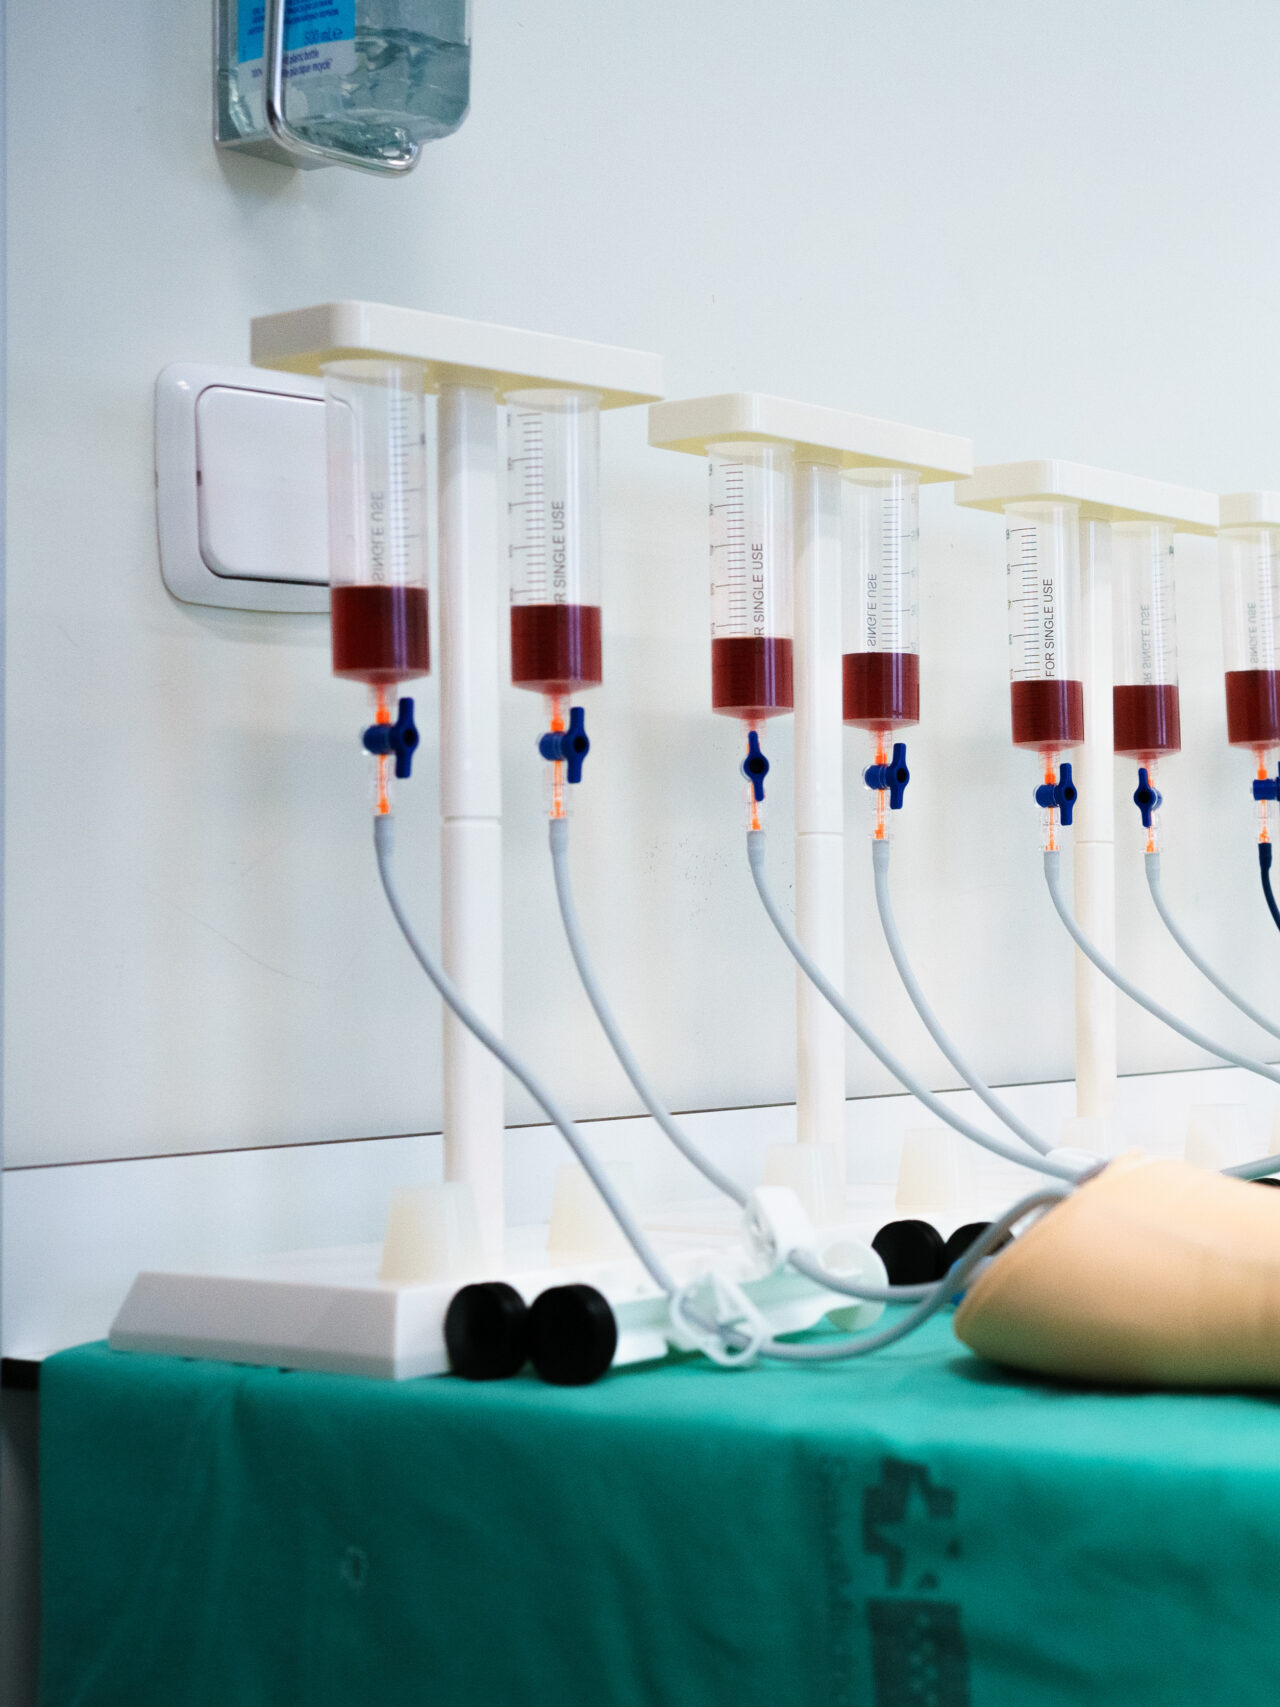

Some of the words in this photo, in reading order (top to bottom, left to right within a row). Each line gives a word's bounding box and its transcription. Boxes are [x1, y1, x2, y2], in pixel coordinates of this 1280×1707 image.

[551, 500, 565, 532] USE
[552, 534, 567, 589] SINGLE
[752, 543, 763, 569] USE
[753, 574, 765, 623] SINGLE
[1043, 578, 1053, 603] USE
[1044, 605, 1055, 649] SINGLE
[1045, 652, 1056, 678] FOR
